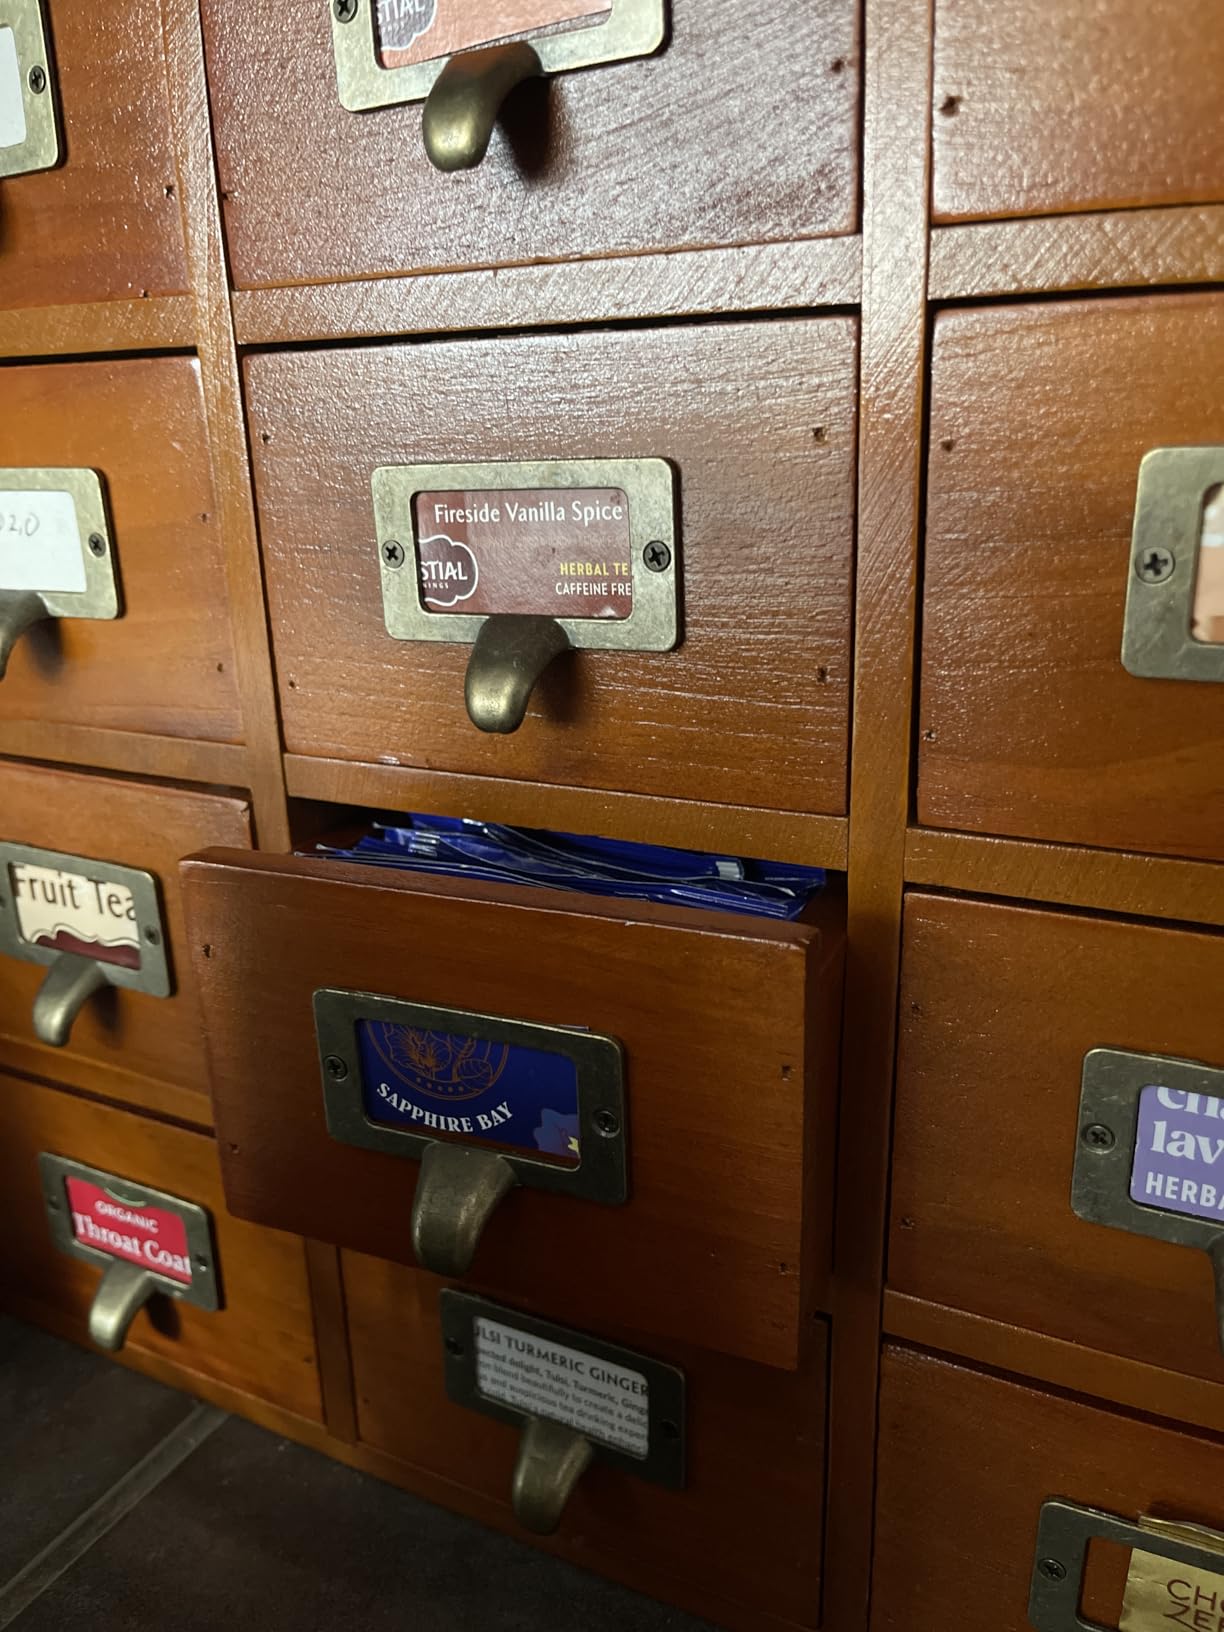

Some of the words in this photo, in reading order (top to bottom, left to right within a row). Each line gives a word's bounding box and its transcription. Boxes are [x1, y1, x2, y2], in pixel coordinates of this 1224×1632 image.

[434, 504, 500, 523] Fireside
[505, 501, 566, 522] Vanilla
[572, 500, 623, 526] Spice
[560, 562, 609, 576] HERBAL
[613, 562, 629, 576] TE
[555, 582, 608, 596] CAFFEINE
[611, 583, 632, 596] FRE
[14, 865, 80, 909] Fruit
[87, 878, 137, 921] Tea
[376, 1083, 474, 1132] SAPPHIRE
[476, 1101, 513, 1130] BAY
[95, 1200, 159, 1233] ORGANIC
[73, 1212, 143, 1257] Throat
[504, 1335, 586, 1376] TURMERIC
[588, 1366, 648, 1397] GINGER
[1167, 1579, 1224, 1612] CH
